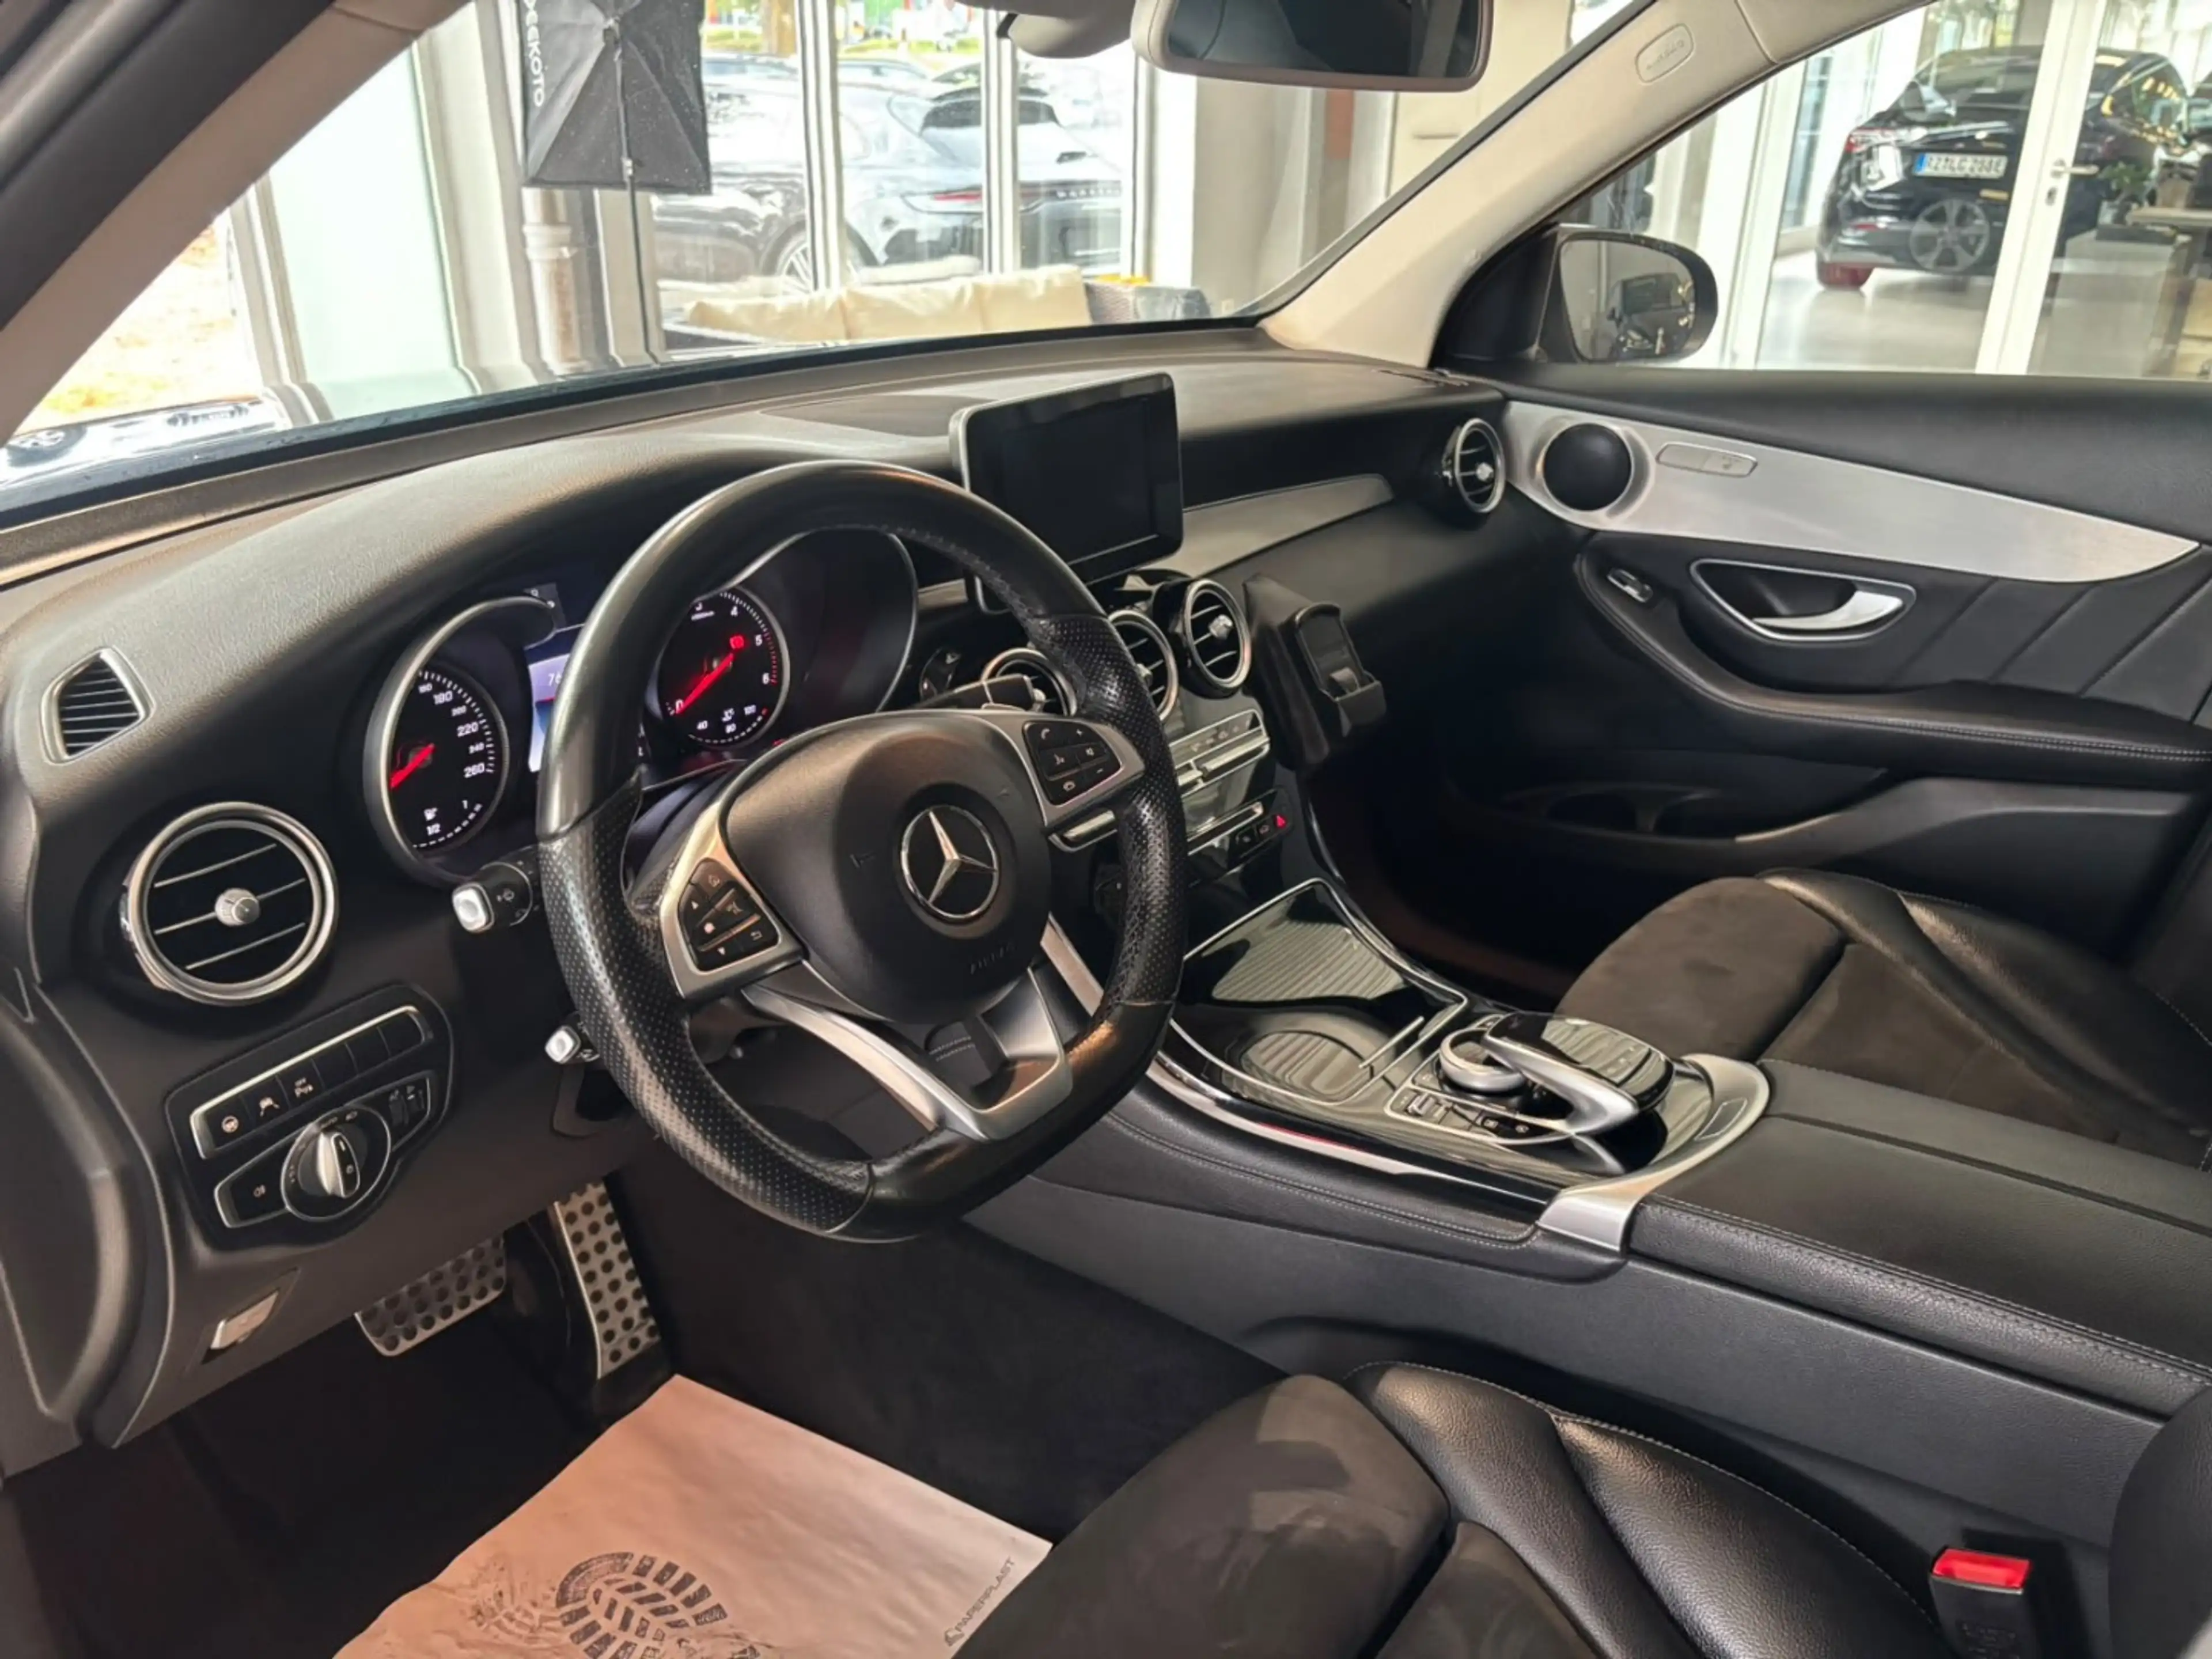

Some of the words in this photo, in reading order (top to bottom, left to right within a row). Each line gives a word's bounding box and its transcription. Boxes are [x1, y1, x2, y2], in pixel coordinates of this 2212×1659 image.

[731, 606, 738, 616] 4
[756, 635, 762, 646] 5
[763, 673, 769, 684] 6
[433, 691, 452, 704] 180
[457, 722, 478, 737] 220
[464, 763, 484, 778] 260
[955, 1555, 1015, 1632] PAPERPLAST
